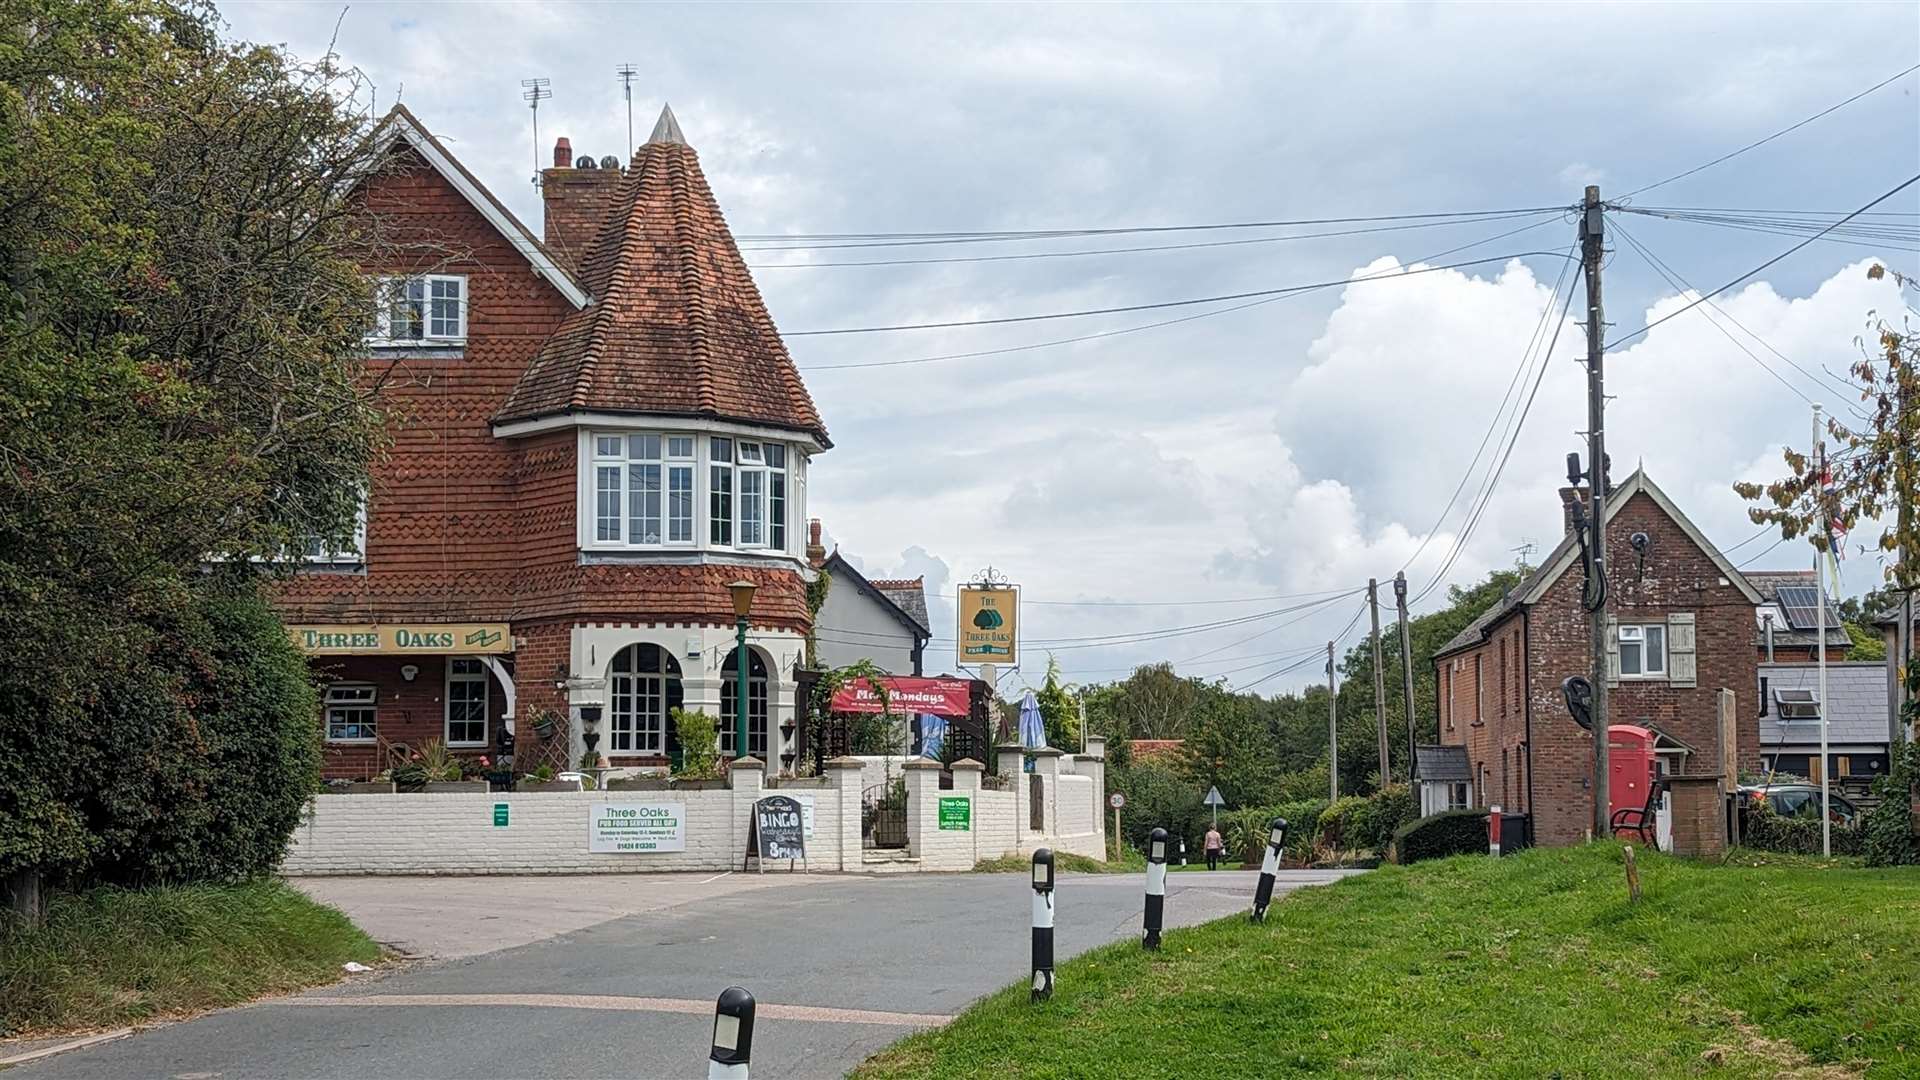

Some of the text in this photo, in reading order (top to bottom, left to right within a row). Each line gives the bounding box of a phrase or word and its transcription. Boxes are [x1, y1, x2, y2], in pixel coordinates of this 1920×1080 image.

[981, 596, 996, 606] THE
[303, 629, 379, 648] THREE
[396, 629, 454, 648] OAKS
[965, 632, 1010, 641] THREE OAKS
[889, 689, 945, 703] Mondays
[1111, 797, 1122, 805] 30
[606, 807, 670, 818] Three Oaks
[599, 818, 676, 827] PUB FOOD SERVED ALL DAY
[760, 812, 799, 827] BINGO
